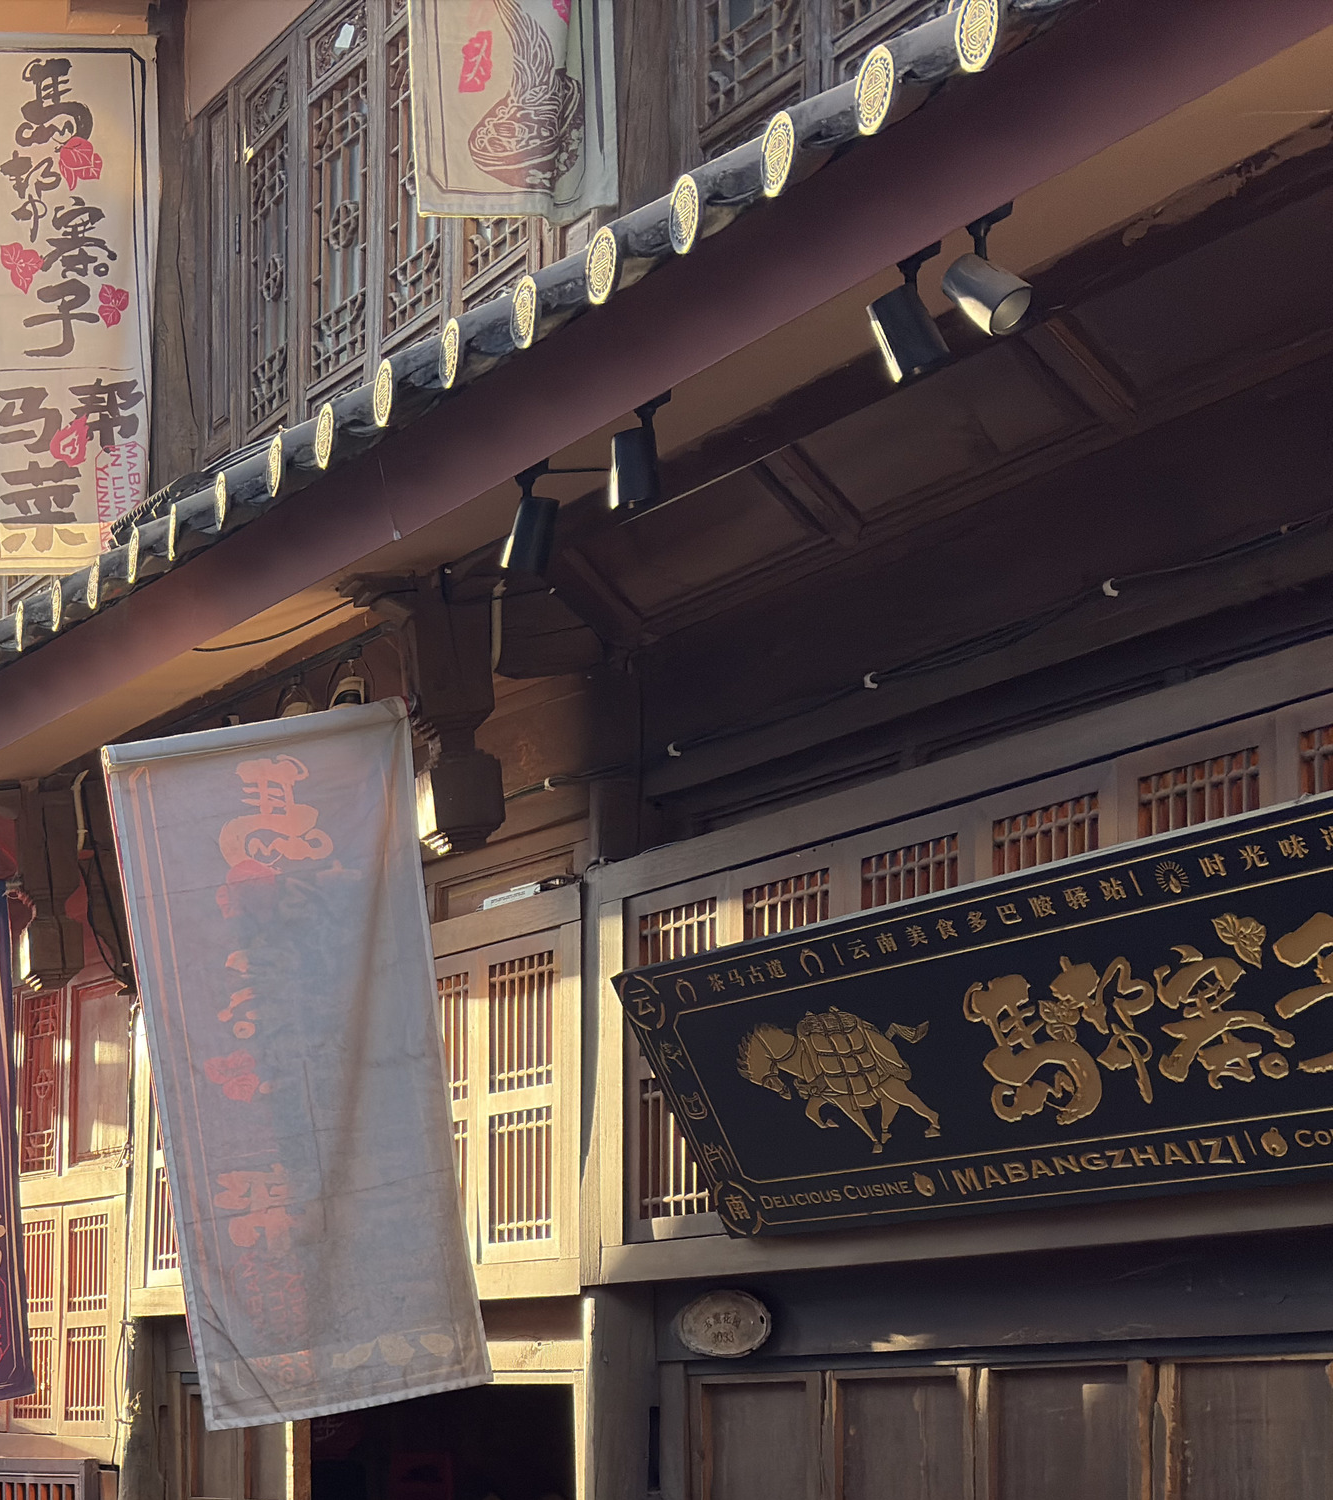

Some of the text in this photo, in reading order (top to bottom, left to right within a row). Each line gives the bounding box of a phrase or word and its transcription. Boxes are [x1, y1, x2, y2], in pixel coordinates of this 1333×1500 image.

[706, 958, 788, 993] 茶马古道
[846, 876, 1128, 962] 云南美食多巴胺驿站
[628, 988, 656, 1016] 云
[954, 1134, 1246, 1195] MABANGZHAIZI
[724, 1193, 751, 1221] 南
